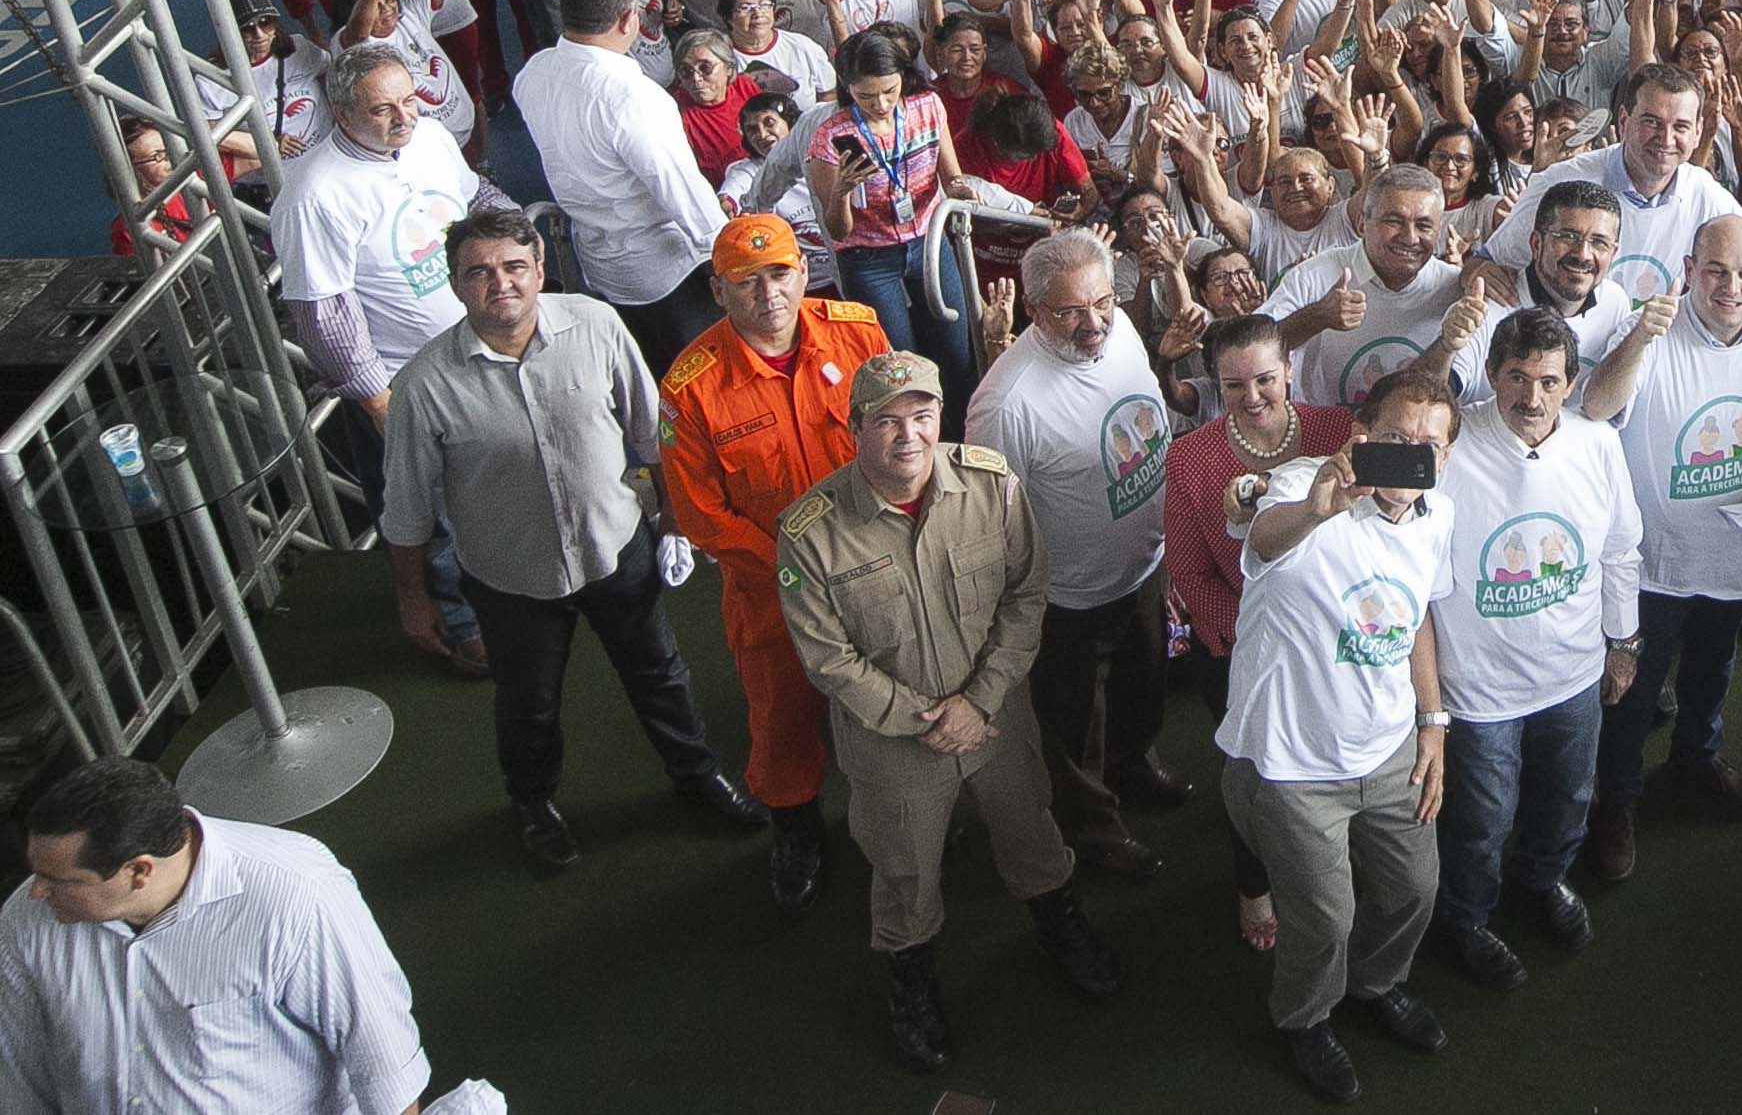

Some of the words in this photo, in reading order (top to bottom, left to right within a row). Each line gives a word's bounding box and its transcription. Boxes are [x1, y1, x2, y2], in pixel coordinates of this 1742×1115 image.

[1675, 485, 1699, 495] PARA
[1700, 484, 1708, 493] A
[1481, 603, 1505, 613] PARA
[1515, 594, 1555, 612] TERCEIRA
